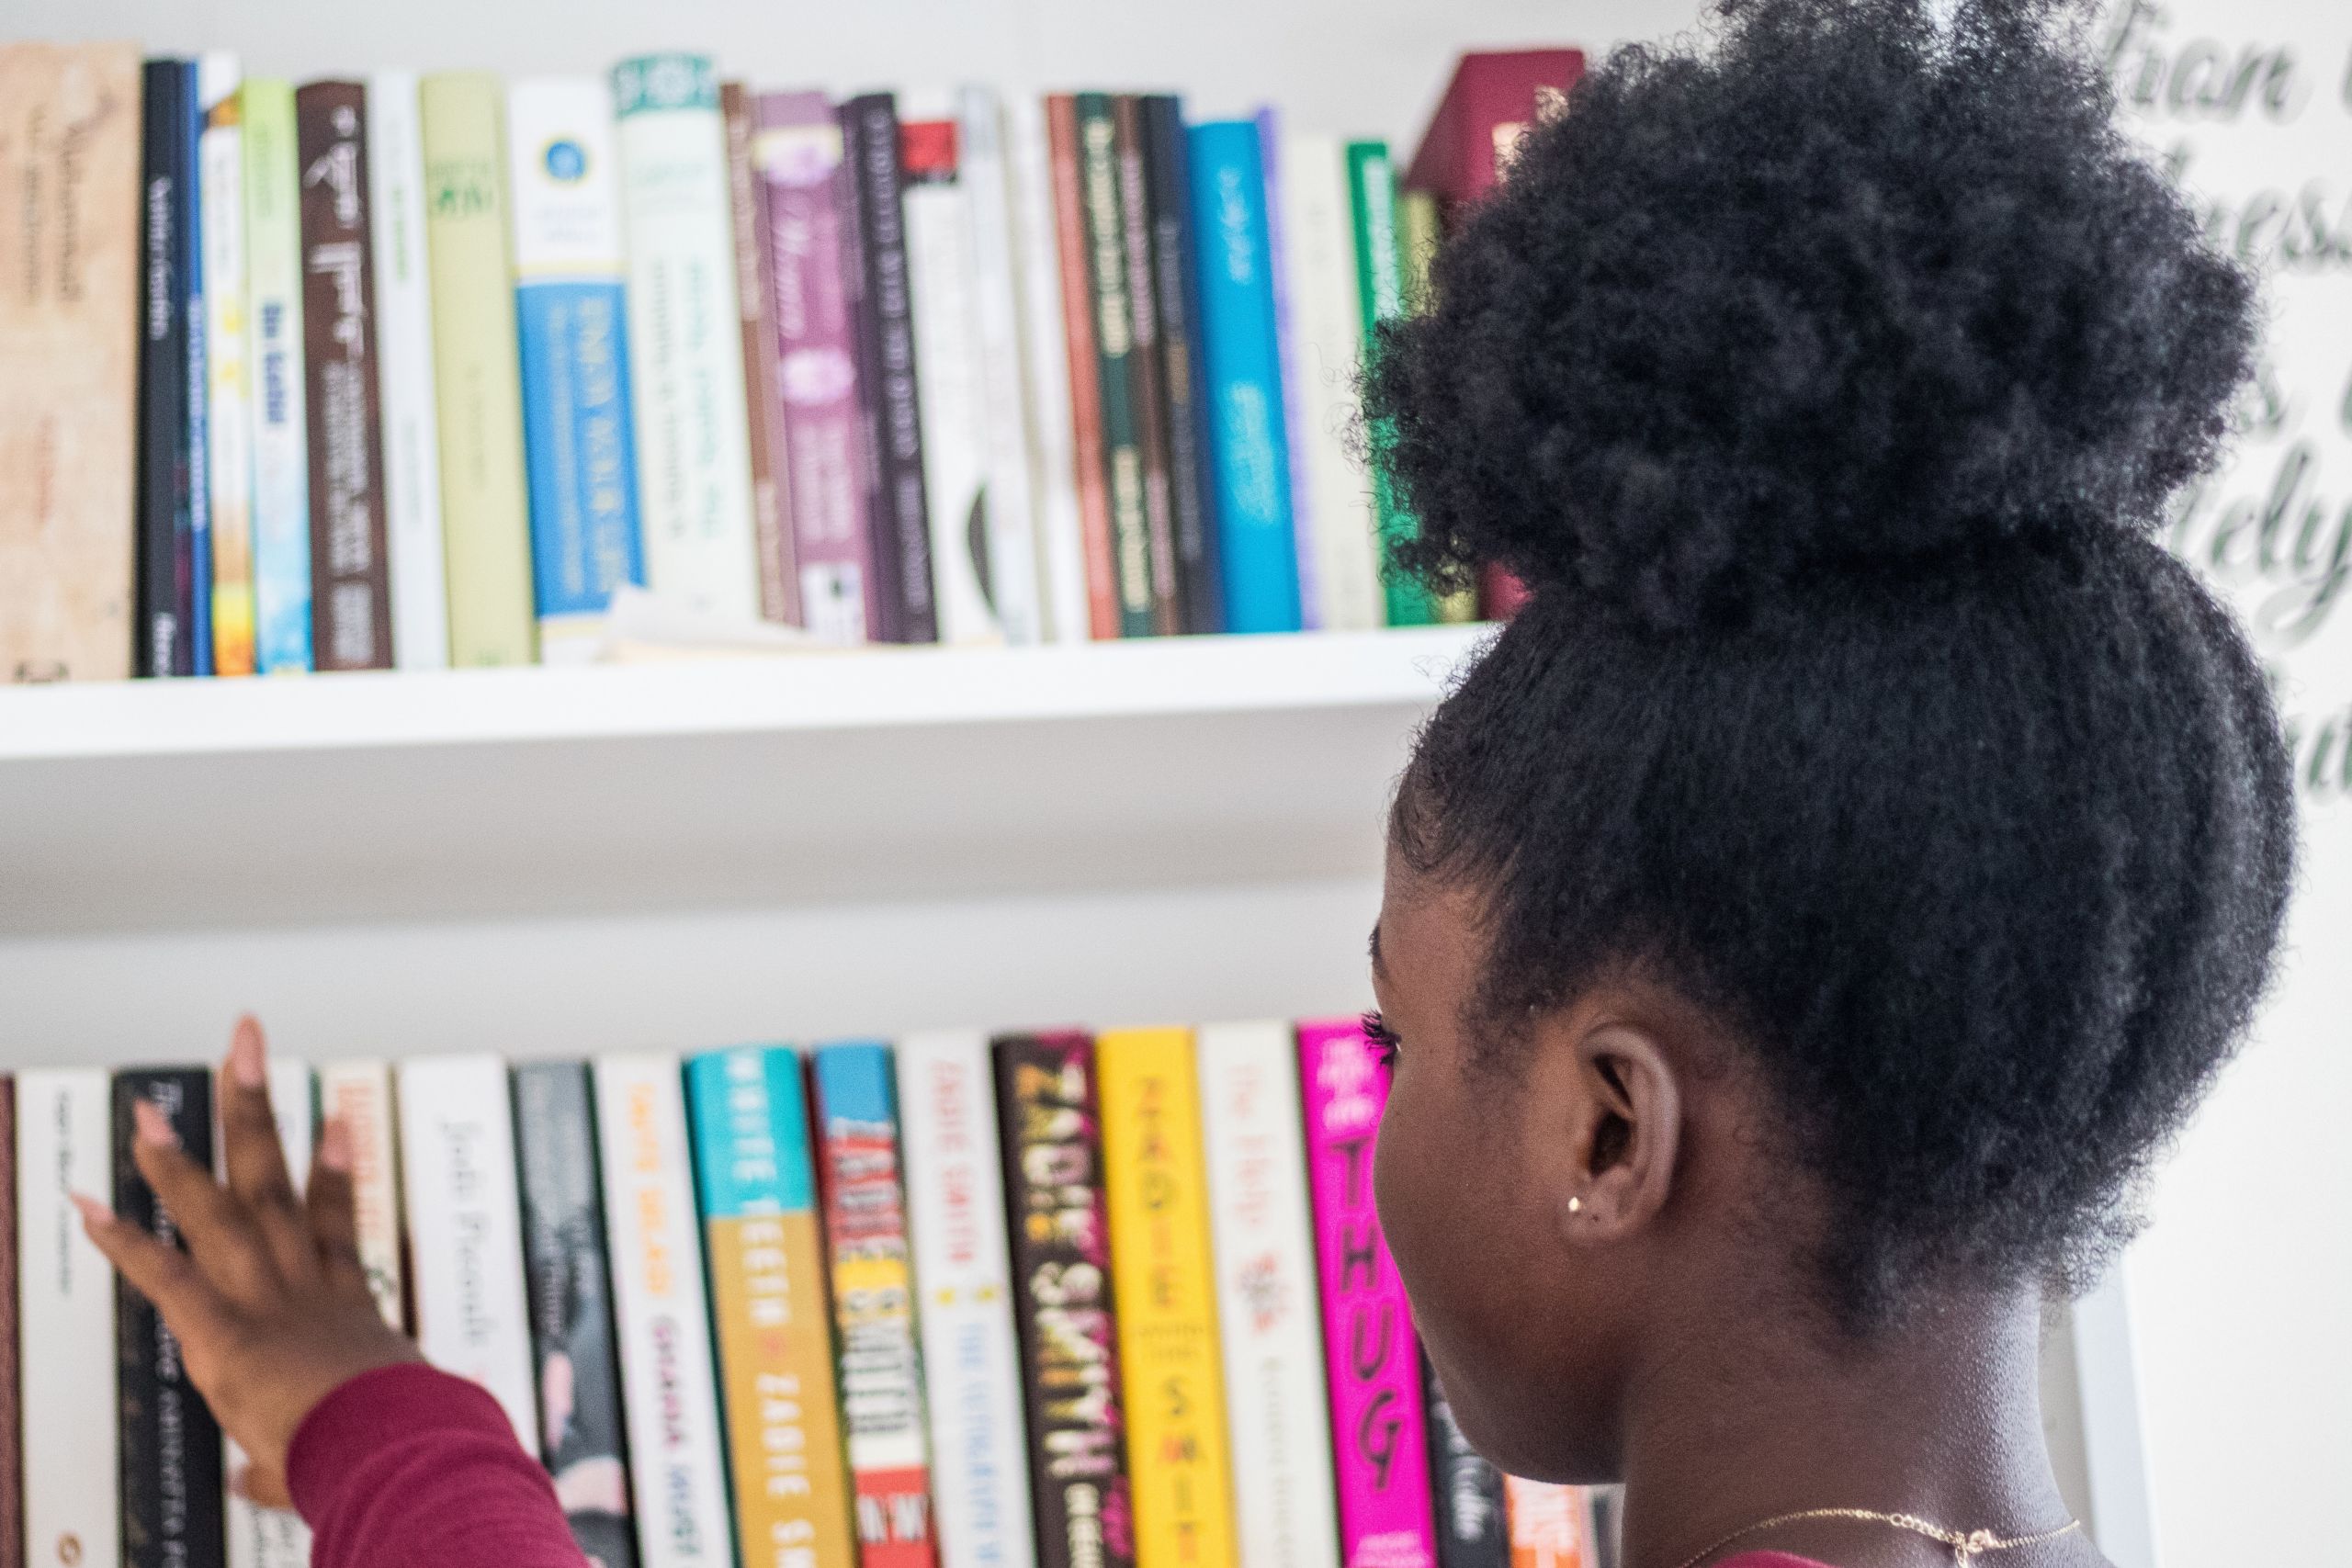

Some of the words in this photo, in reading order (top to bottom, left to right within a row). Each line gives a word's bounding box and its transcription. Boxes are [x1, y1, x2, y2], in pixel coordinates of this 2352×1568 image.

[726, 1048, 777, 1181] WHITE
[932, 1058, 976, 1154] ZADIE
[1014, 1059, 1106, 1250] ZADIE
[825, 1116, 907, 1260] ZADIE
[941, 1165, 978, 1266] SMITH
[742, 1197, 792, 1327] TEETH
[1328, 1134, 1406, 1490] THUG
[651, 1316, 686, 1451] GHANA
[836, 1286, 922, 1433] SMITH
[1030, 1258, 1115, 1477] SMITH
[756, 1372, 812, 1497] ZADIE
